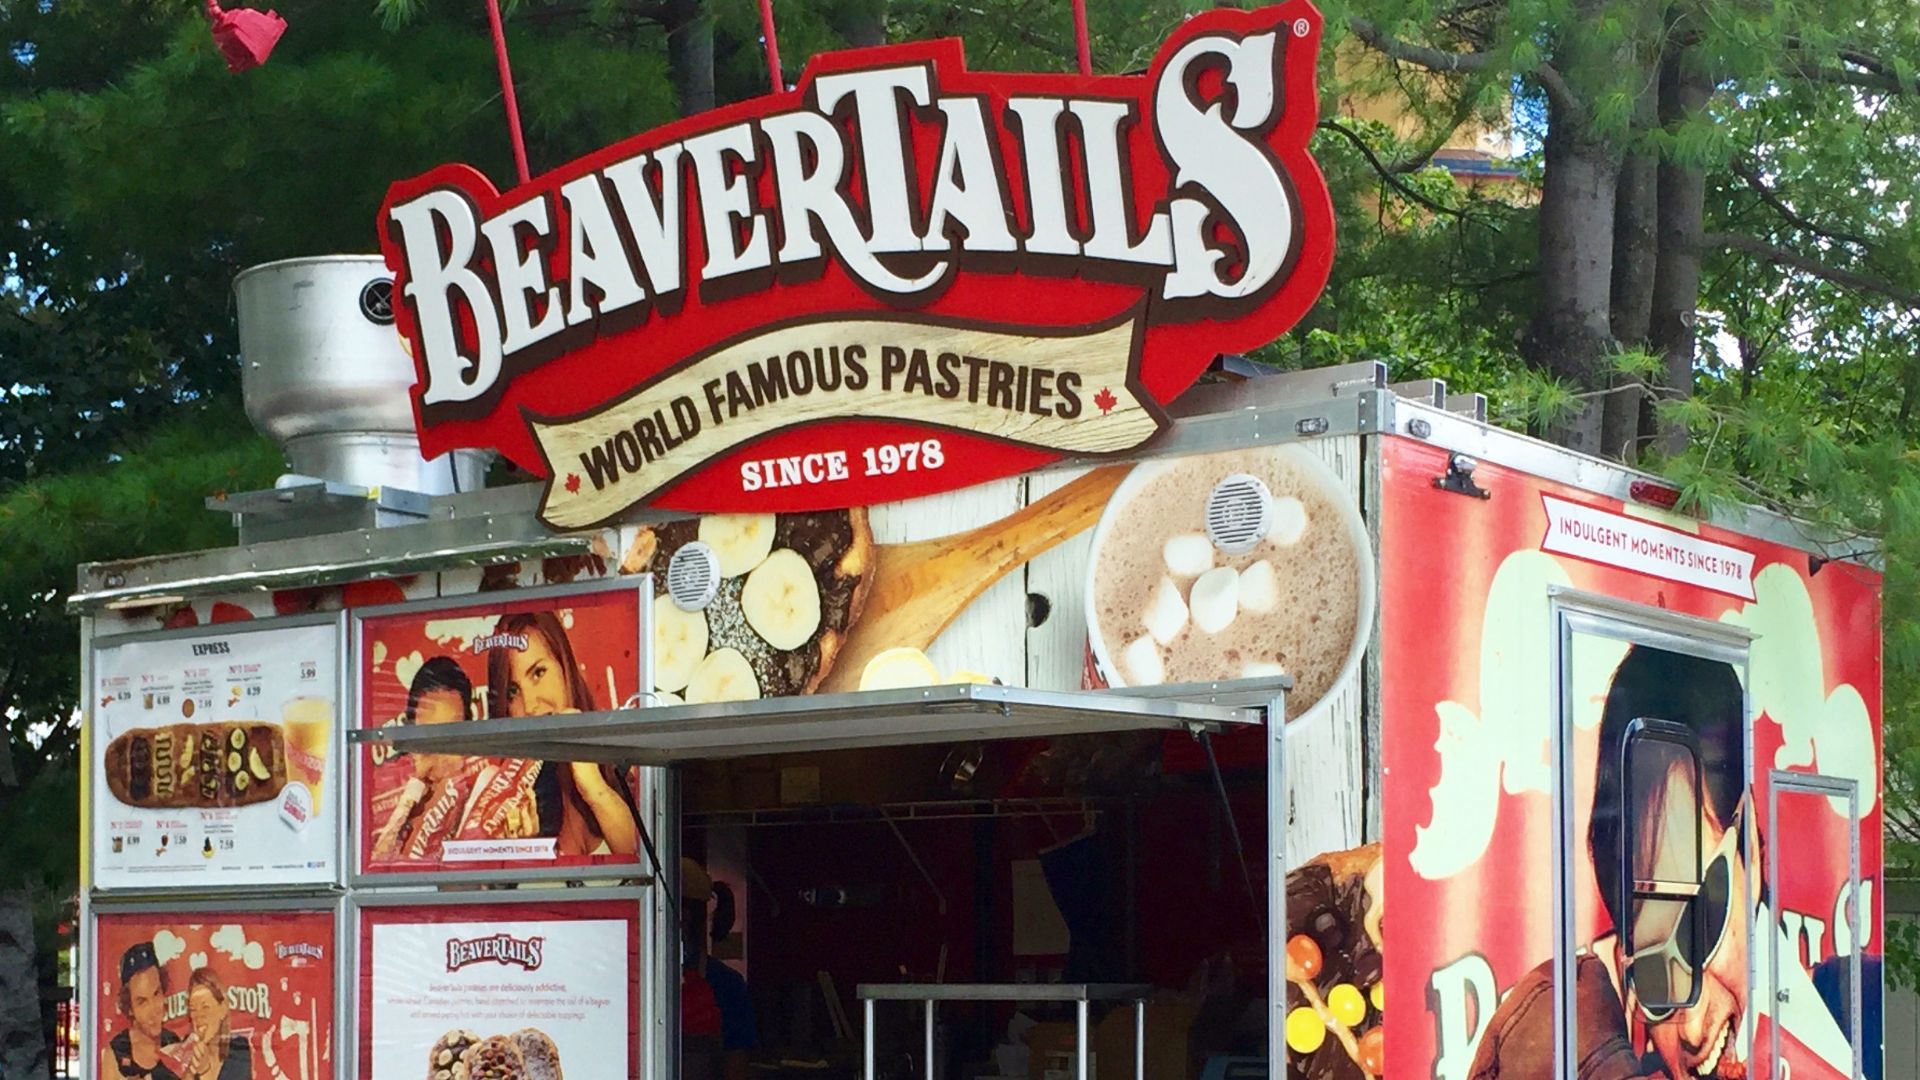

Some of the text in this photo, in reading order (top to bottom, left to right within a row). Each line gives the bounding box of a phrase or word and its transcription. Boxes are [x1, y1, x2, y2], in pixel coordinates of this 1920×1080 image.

[390, 32, 1292, 405] BEAVERTAILS
[579, 345, 1082, 491] WORLD FAMOUS PASTRIES
[742, 440, 945, 491] SINCE 1978
[1560, 517, 1743, 580] INDULGENT MOMENTS SINCE 1978
[192, 642, 230, 656] EXPRESS
[450, 935, 541, 969] BEAVERTAILS
